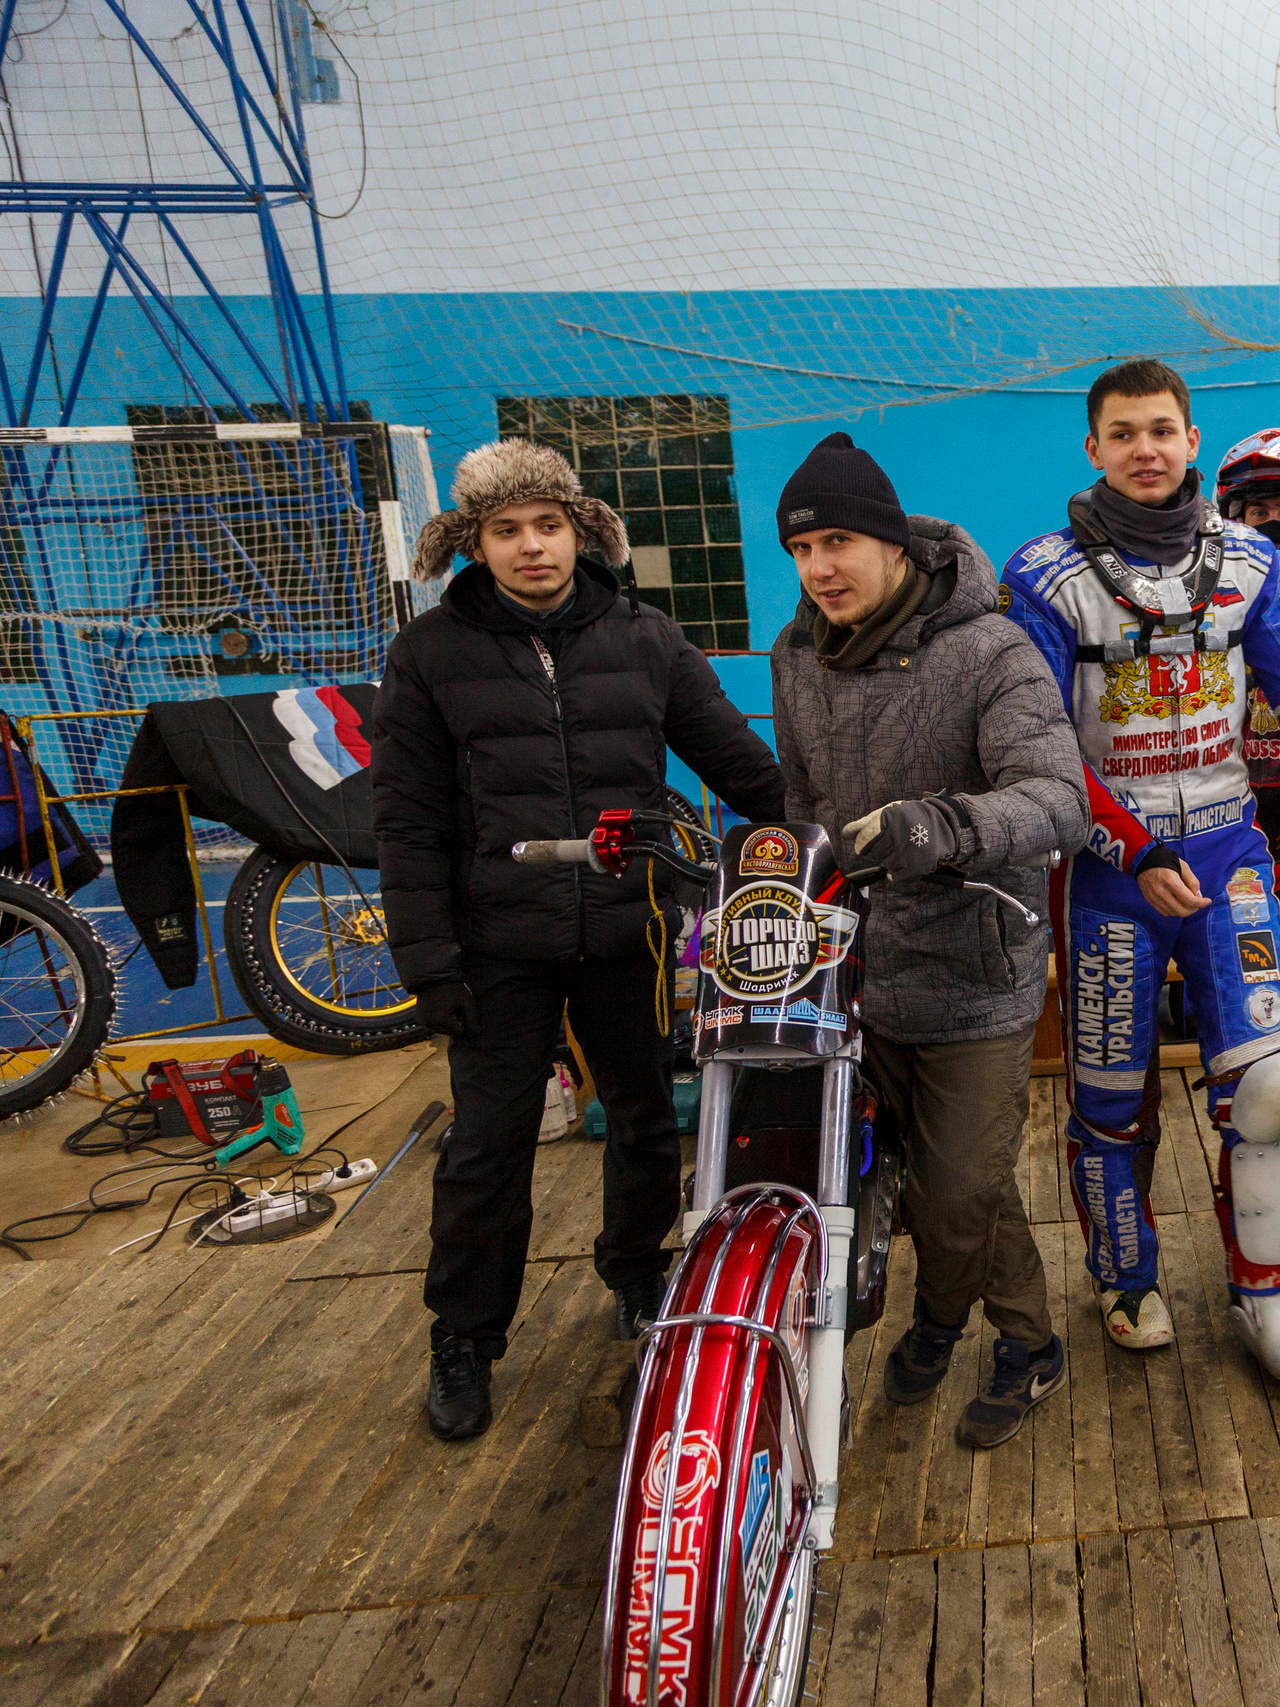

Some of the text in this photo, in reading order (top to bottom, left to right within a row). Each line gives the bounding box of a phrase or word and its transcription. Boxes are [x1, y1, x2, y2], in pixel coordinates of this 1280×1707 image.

[1201, 718, 1230, 741] СПОРТА
[730, 918, 816, 947] ТОРПЕДО
[739, 971, 799, 993] Шадринск
[1099, 921, 1135, 1065] УРАЛЬСКИЙ
[706, 1006, 742, 1020] УГМК
[820, 1012, 845, 1023] SHAAZ
[187, 1079, 226, 1092] ЗУБ
[1116, 1187, 1139, 1269] ОБЛАСТЬ
